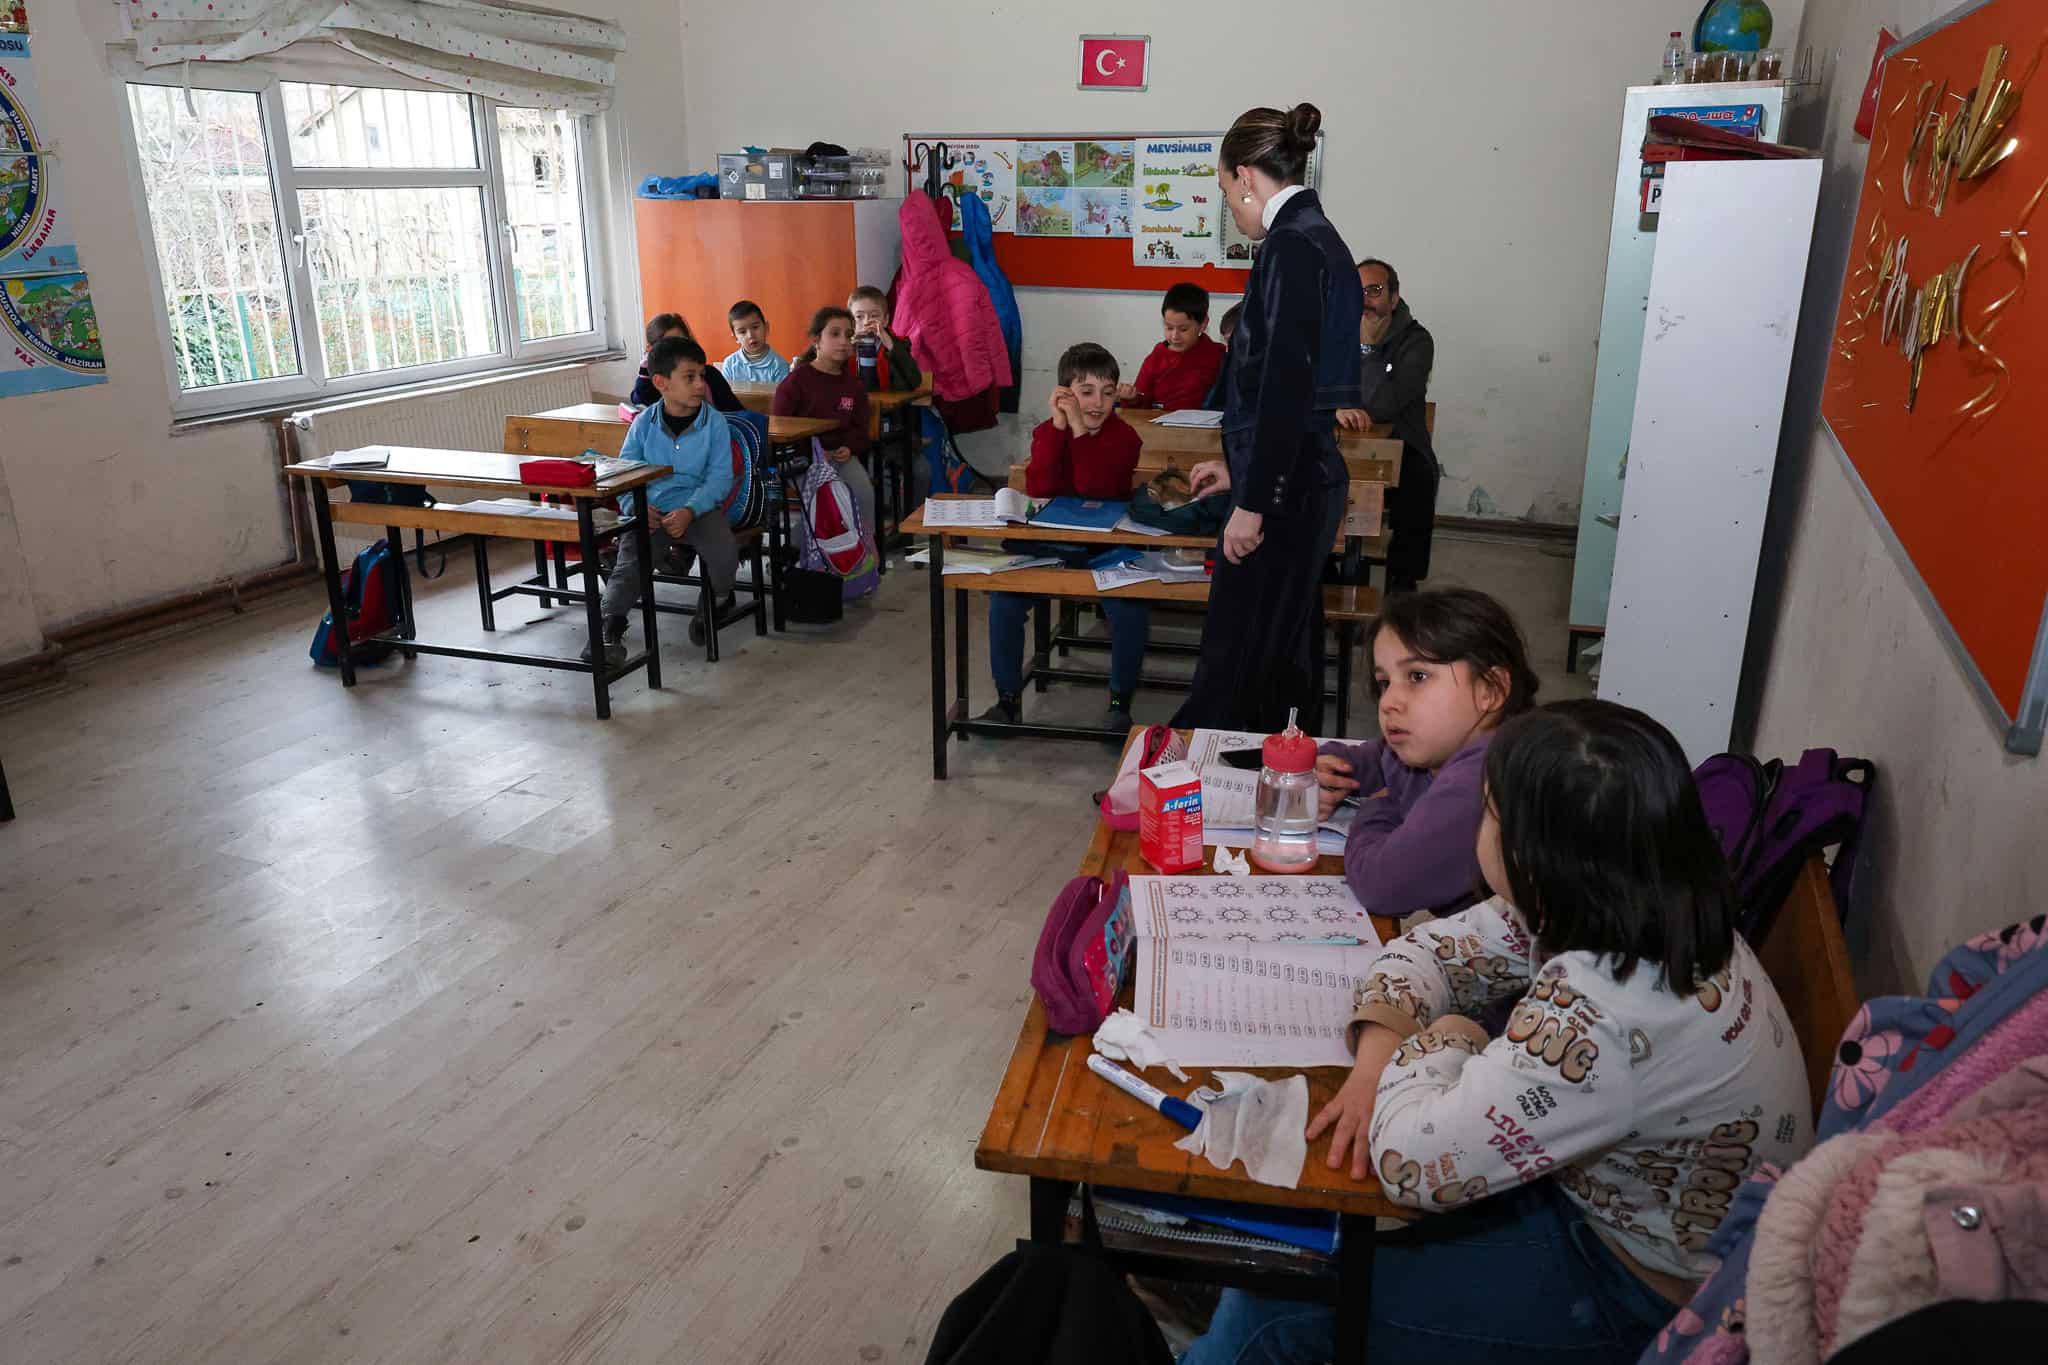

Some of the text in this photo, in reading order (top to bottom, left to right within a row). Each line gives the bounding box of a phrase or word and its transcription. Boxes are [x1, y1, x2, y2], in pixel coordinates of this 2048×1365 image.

[9, 110, 29, 141] ŞUBAT
[1147, 140, 1213, 154] MEVSİMLER
[31, 167, 39, 194] MART
[11, 211, 31, 238] NİSAN
[22, 208, 57, 261] İLKBAHAR
[24, 328, 60, 358] TEMMUZ
[15, 346, 36, 368] YAZ
[64, 356, 103, 368] HAZİRAN
[1536, 1085, 1557, 1108] GOOD
[1485, 1105, 1535, 1147] LIVE
